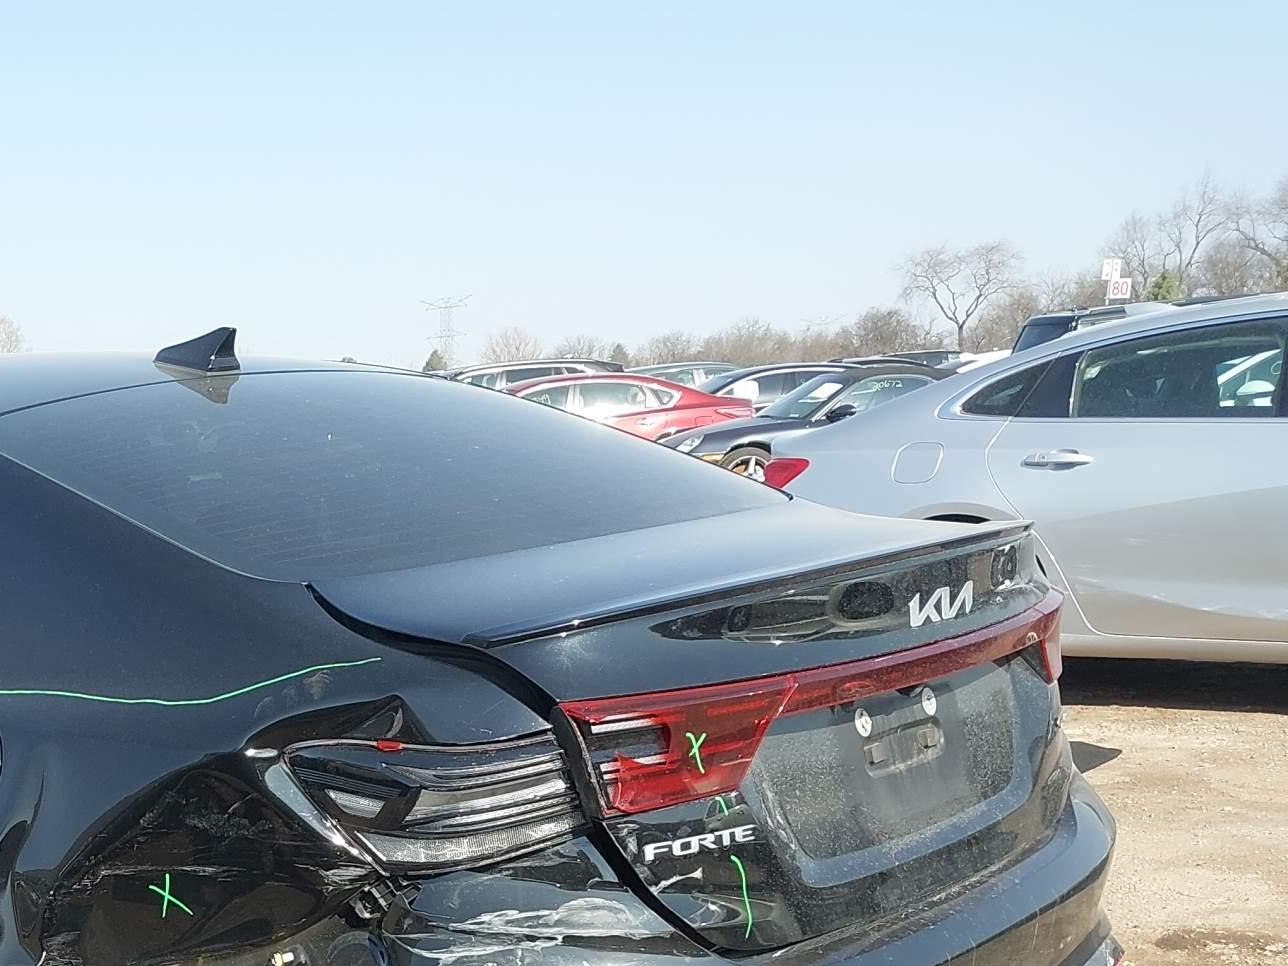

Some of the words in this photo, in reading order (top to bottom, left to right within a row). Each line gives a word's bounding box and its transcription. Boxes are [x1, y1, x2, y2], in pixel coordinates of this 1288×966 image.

[1111, 280, 1129, 297] 80
[907, 579, 974, 628] KIA
[642, 823, 758, 862] FORTE
